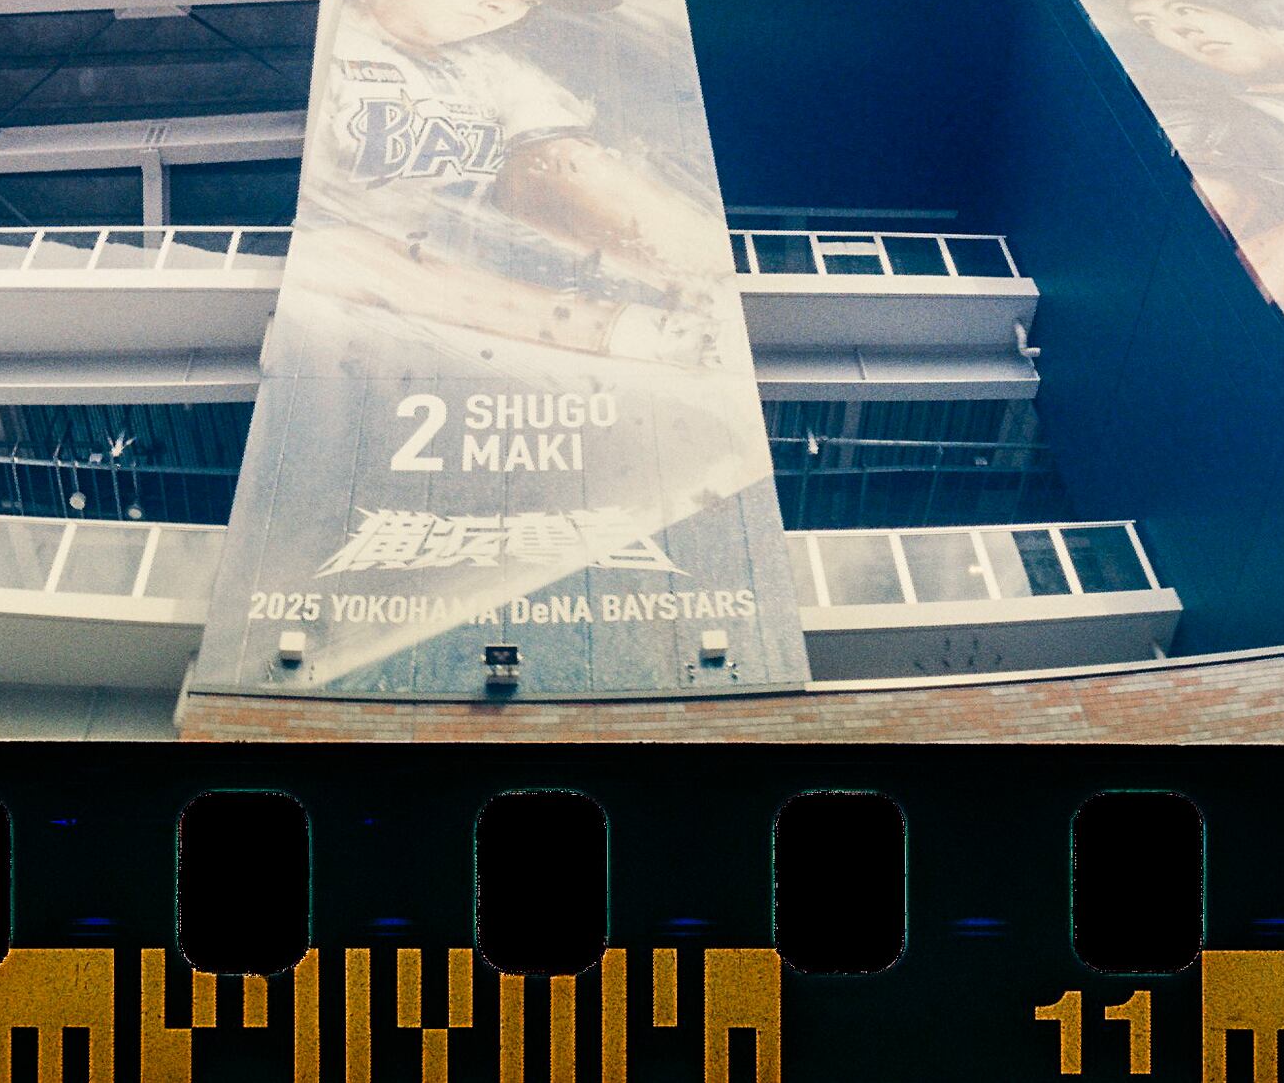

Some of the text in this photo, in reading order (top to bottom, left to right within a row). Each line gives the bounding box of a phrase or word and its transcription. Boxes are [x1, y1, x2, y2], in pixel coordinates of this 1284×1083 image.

[390, 393, 617, 472] 2 SHUGO
[462, 433, 584, 472] MAKI
[248, 589, 757, 625] 2025 YOKOHAMA DeNA BAYSTARS
[1034, 990, 1153, 1075] 11
